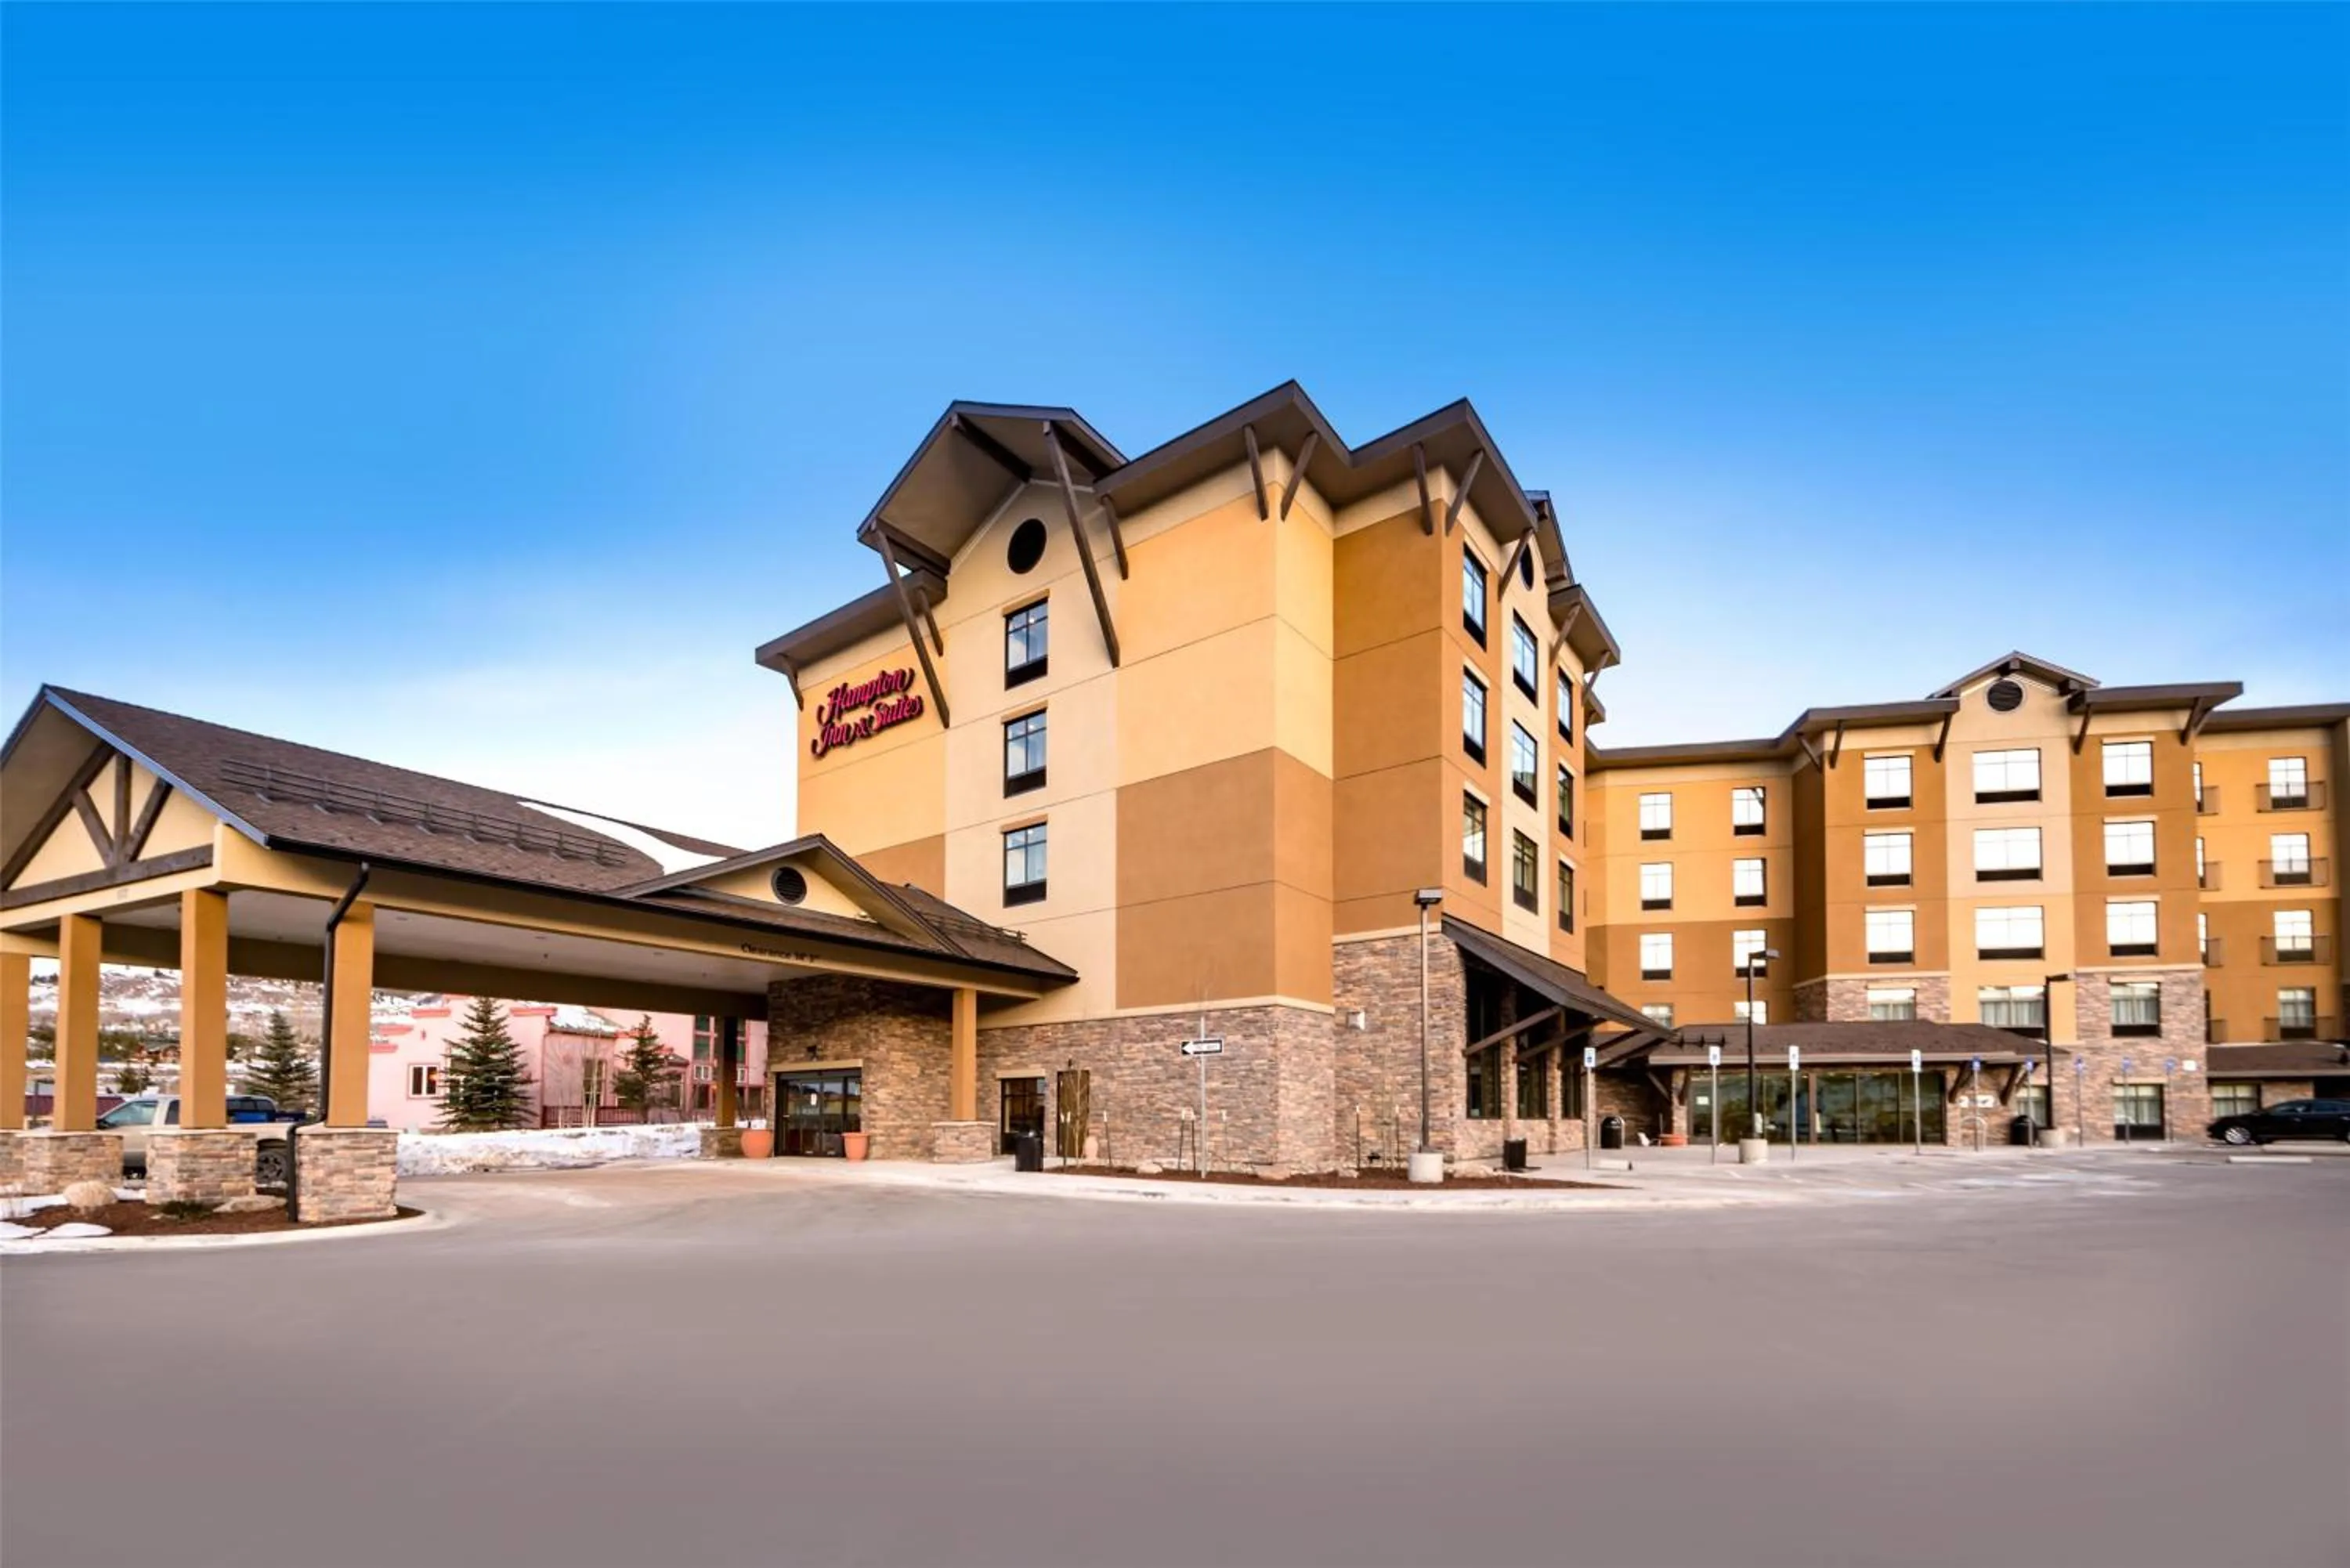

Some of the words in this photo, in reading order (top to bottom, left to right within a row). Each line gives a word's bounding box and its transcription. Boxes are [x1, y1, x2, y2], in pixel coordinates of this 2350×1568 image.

[812, 721, 855, 760] Inn
[868, 694, 924, 736] Suites
[817, 667, 915, 725] Hampton
